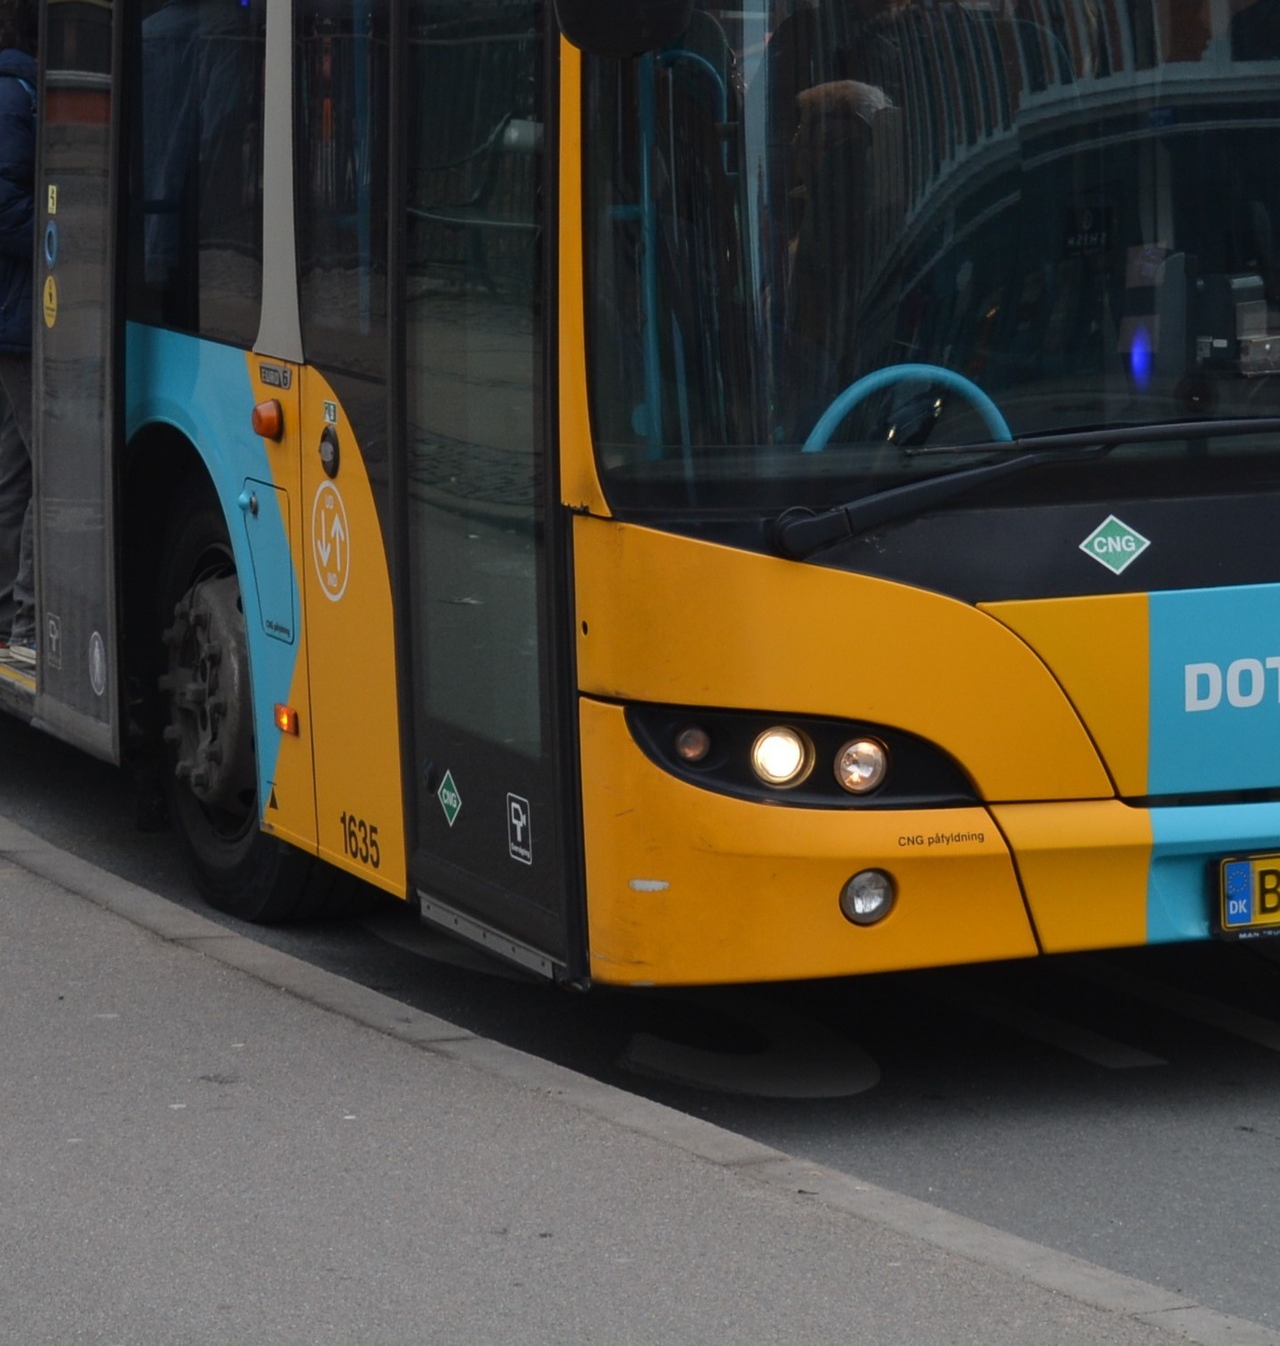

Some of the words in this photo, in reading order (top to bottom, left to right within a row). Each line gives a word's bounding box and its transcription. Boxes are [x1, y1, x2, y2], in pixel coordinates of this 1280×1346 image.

[1093, 535, 1136, 554] CNG
[441, 788, 458, 809] CNG
[340, 811, 380, 869] 1635
[898, 835, 925, 847] CNG
[927, 832, 985, 846] påfyldning
[1229, 899, 1248, 915] DK
